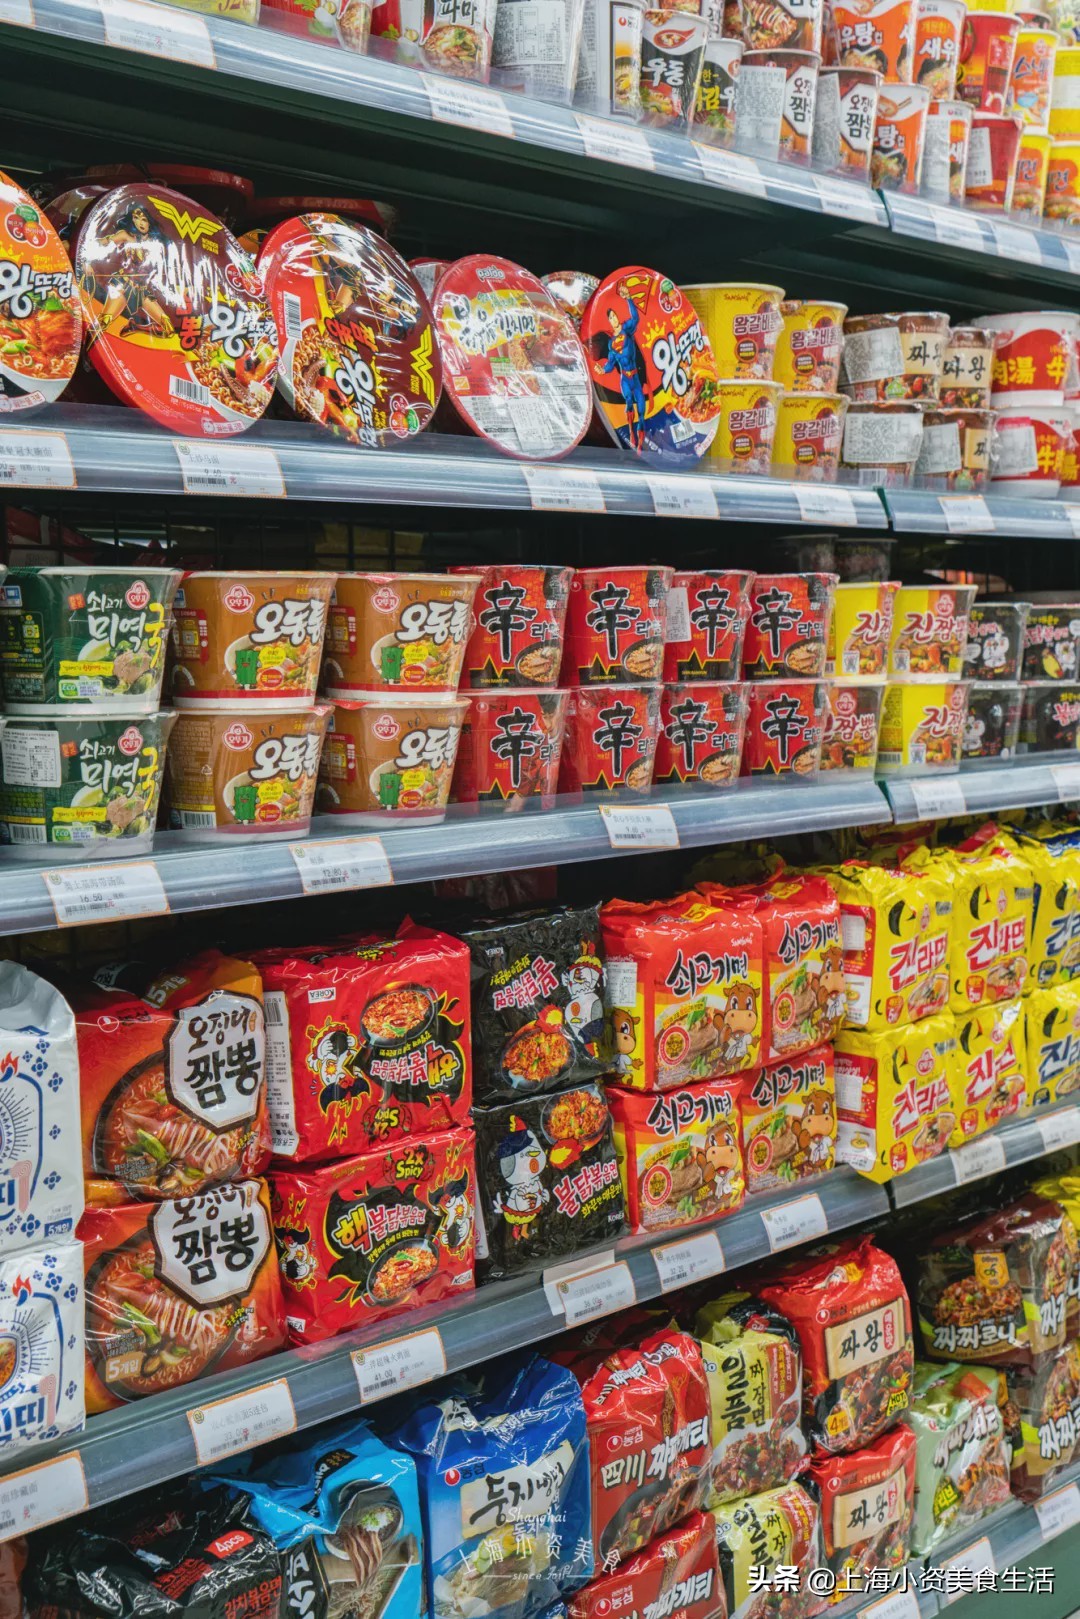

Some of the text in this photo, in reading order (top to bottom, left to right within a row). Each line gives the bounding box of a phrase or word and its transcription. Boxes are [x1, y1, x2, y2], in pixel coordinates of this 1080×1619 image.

[642, 58, 684, 87] 우동
[0, 260, 73, 319] 왕뚜껑
[476, 266, 506, 281] paldo
[734, 312, 783, 335] 왕갈비
[652, 321, 707, 396] 왕뚜껑
[942, 355, 986, 381] 짜왕
[335, 354, 378, 448] 왕뚜껑
[729, 407, 774, 430] 왕갈비
[87, 590, 123, 613] 쇠고기
[249, 598, 327, 647] 오동통
[394, 600, 471, 646] 오동통
[479, 579, 538, 664] 辛
[585, 581, 641, 661] 辛
[690, 582, 737, 658] 辛
[751, 585, 802, 661] 辛
[87, 603, 165, 669] 미역국
[80, 738, 115, 760] 쇠고기
[490, 706, 546, 789] 辛
[592, 700, 644, 778] 辛
[665, 698, 719, 772] 辛
[760, 693, 809, 764] 辛
[80, 747, 159, 812] 미역국
[79, 893, 103, 904] 16.50
[779, 918, 840, 964] 쇠고기면
[889, 932, 948, 993] 진라면
[966, 916, 1027, 974] 진라면
[309, 987, 336, 998] KOREA
[492, 955, 560, 1011] 불닭볶음면
[666, 948, 748, 998] 쇠고기면
[187, 1005, 252, 1054] 오징어
[183, 1037, 261, 1110] 짬뽕
[369, 1040, 461, 1089] 핵불닭볶음면
[752, 1061, 827, 1109] 쇠고기면
[374, 1106, 400, 1128] Spicy
[647, 1090, 733, 1137] 쇠고기면
[395, 1161, 424, 1181] Spicy
[552, 1159, 619, 1218] 불닭볶음면
[172, 1184, 251, 1230] 오징어
[331, 1203, 426, 1255] 핵불닭볶음면
[171, 1212, 260, 1286] 짬뽕
[838, 1319, 884, 1361] 짜왕
[932, 1322, 1018, 1353] 짜짜로니
[108, 1357, 141, 1380] 5개입
[374, 1369, 394, 1382] 41.00
[720, 1351, 752, 1434] 일품
[749, 1358, 767, 1429] 짜장면
[623, 1430, 644, 1447] 농심
[461, 1462, 486, 1480] 농심
[600, 1448, 648, 1489] 四川
[846, 1489, 886, 1528] 짜왕
[214, 1533, 246, 1554] 4pcs
[223, 1574, 283, 1618] 김치볶음면
[611, 1592, 634, 1610] 농심
